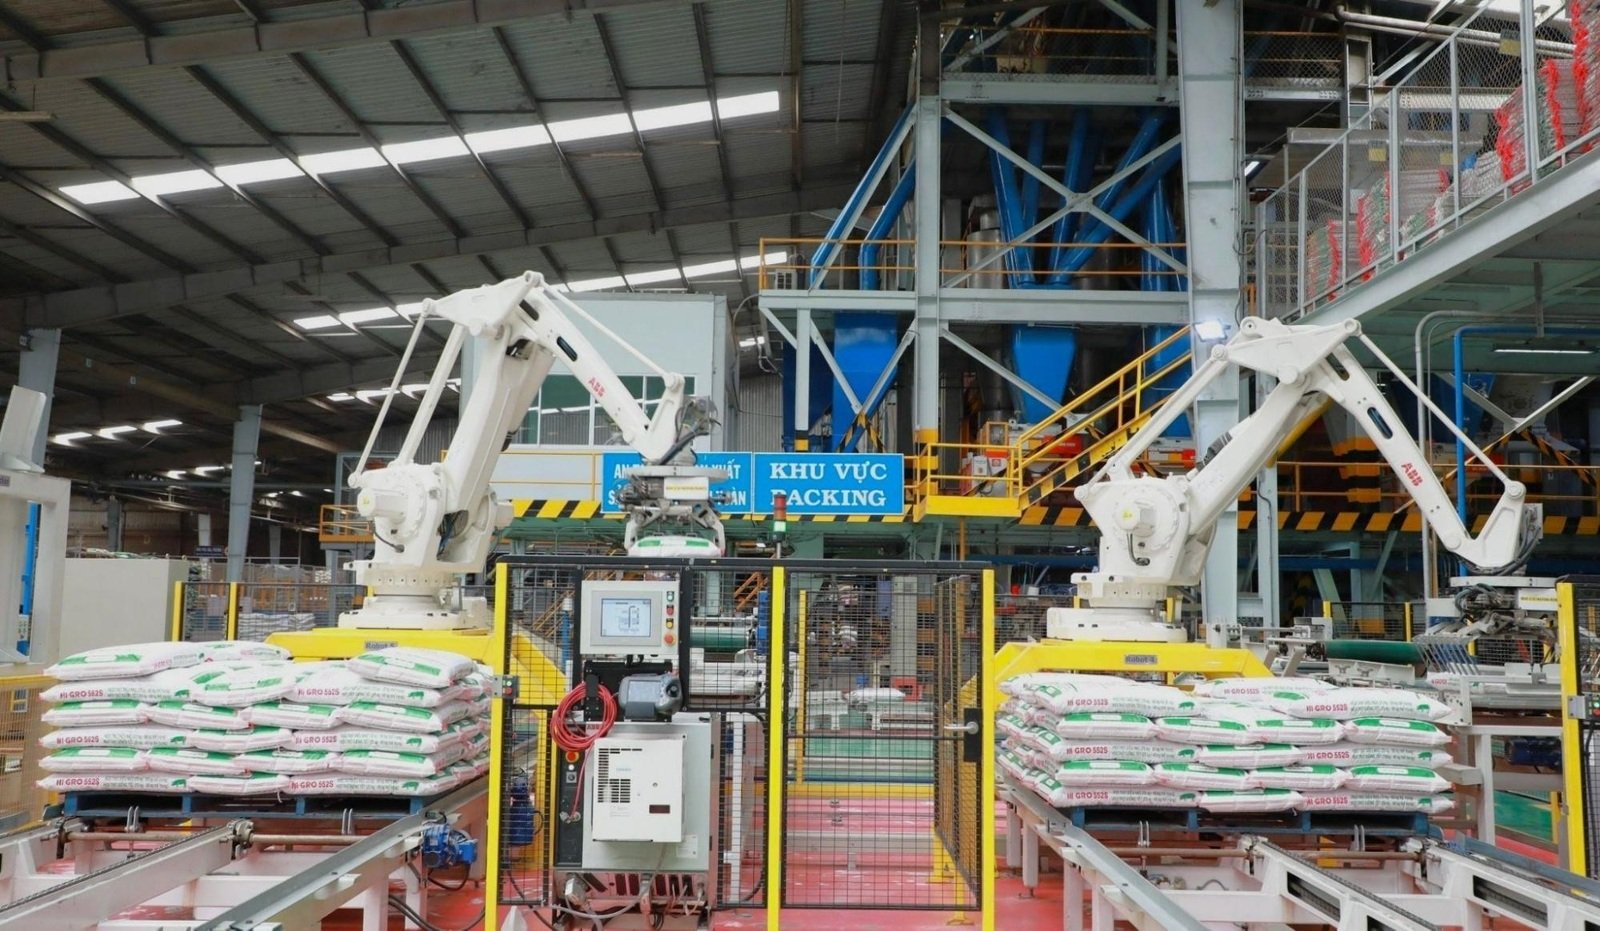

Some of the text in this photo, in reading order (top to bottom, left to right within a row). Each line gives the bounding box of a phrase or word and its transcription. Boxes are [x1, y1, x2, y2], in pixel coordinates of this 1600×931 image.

[588, 377, 606, 397] ABB
[769, 460, 888, 484] KHU VỰC
[1401, 462, 1423, 486] ABB
[69, 690, 87, 698] GRO
[306, 688, 323, 696] GRO
[1314, 704, 1332, 712] GRO
[65, 736, 83, 744] GRO
[304, 736, 320, 744] GRO
[65, 778, 83, 786] GRO
[1314, 797, 1332, 805] GRO
